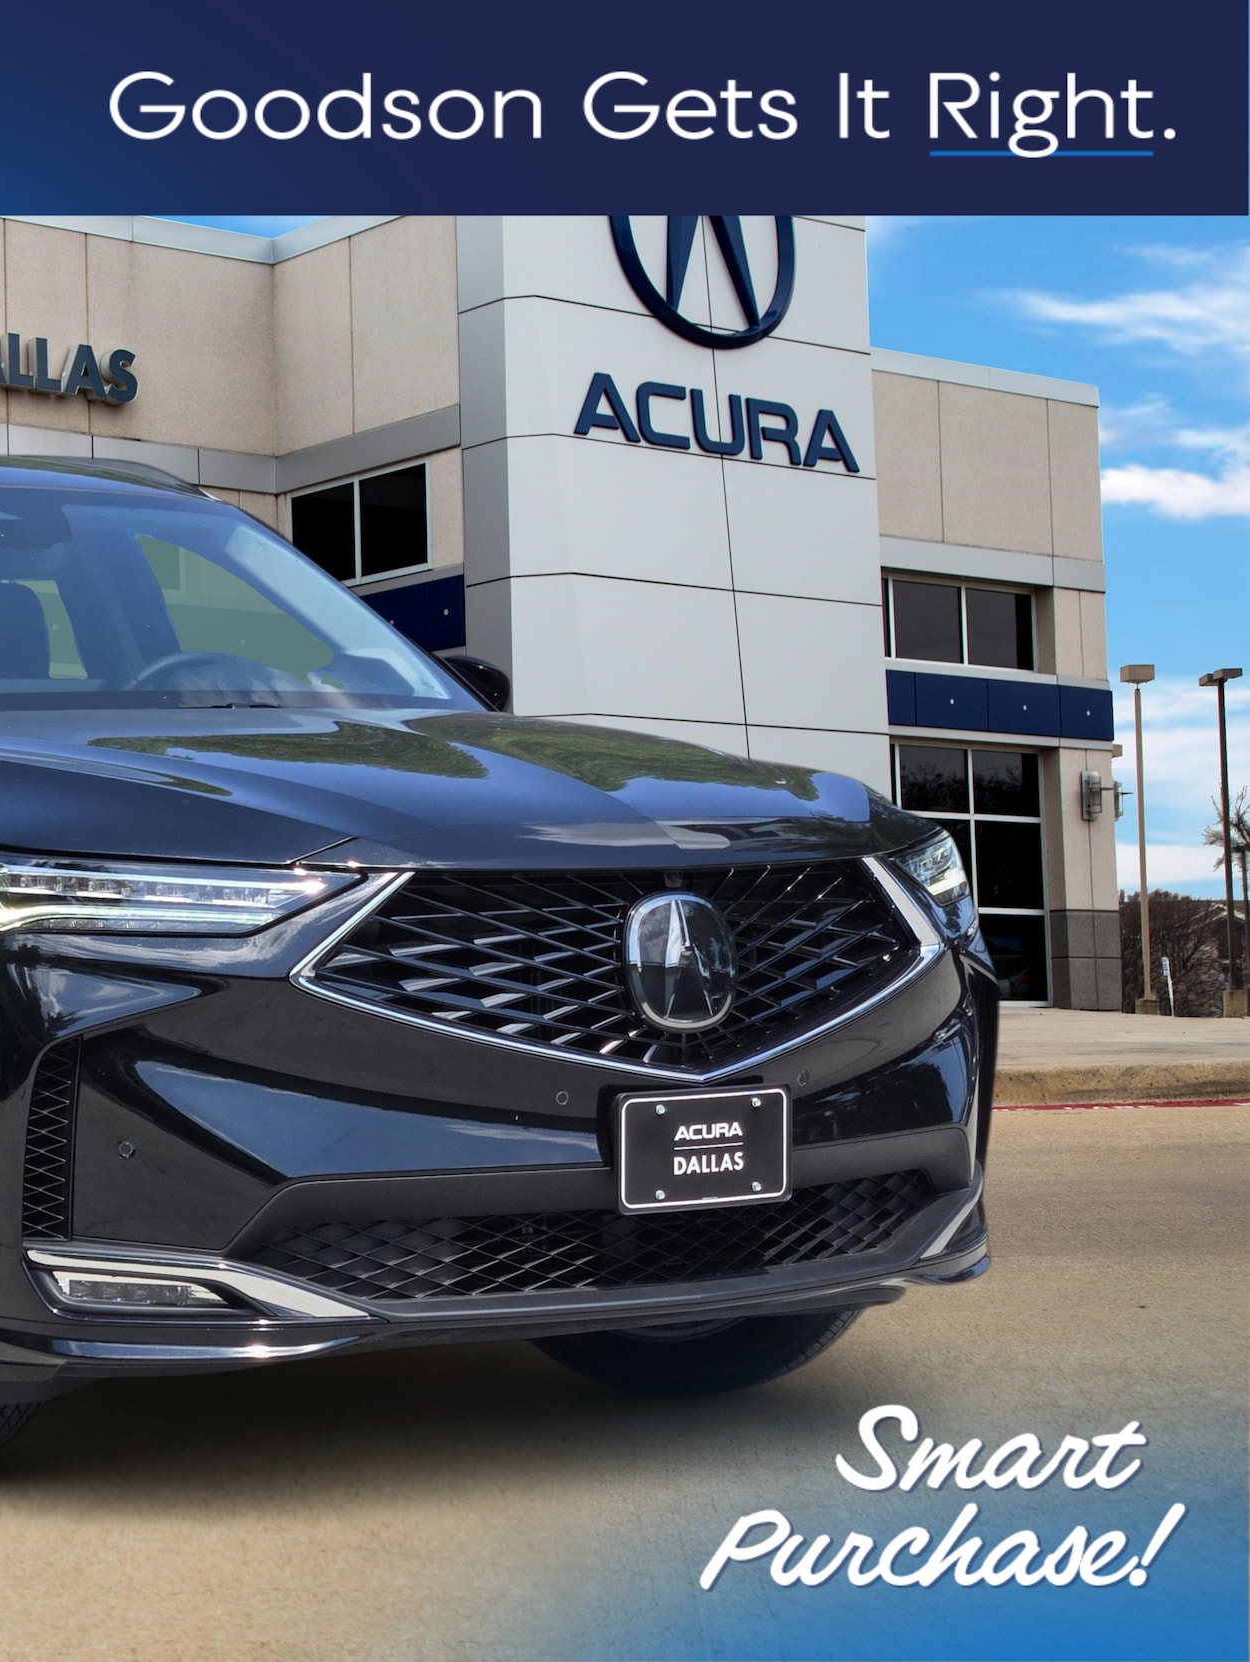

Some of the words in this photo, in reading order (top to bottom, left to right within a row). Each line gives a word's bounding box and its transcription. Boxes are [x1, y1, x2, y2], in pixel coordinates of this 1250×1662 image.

[573, 371, 860, 473] ACURA
[674, 1121, 744, 1142] ACURA
[673, 1151, 744, 1176] DALLAS
